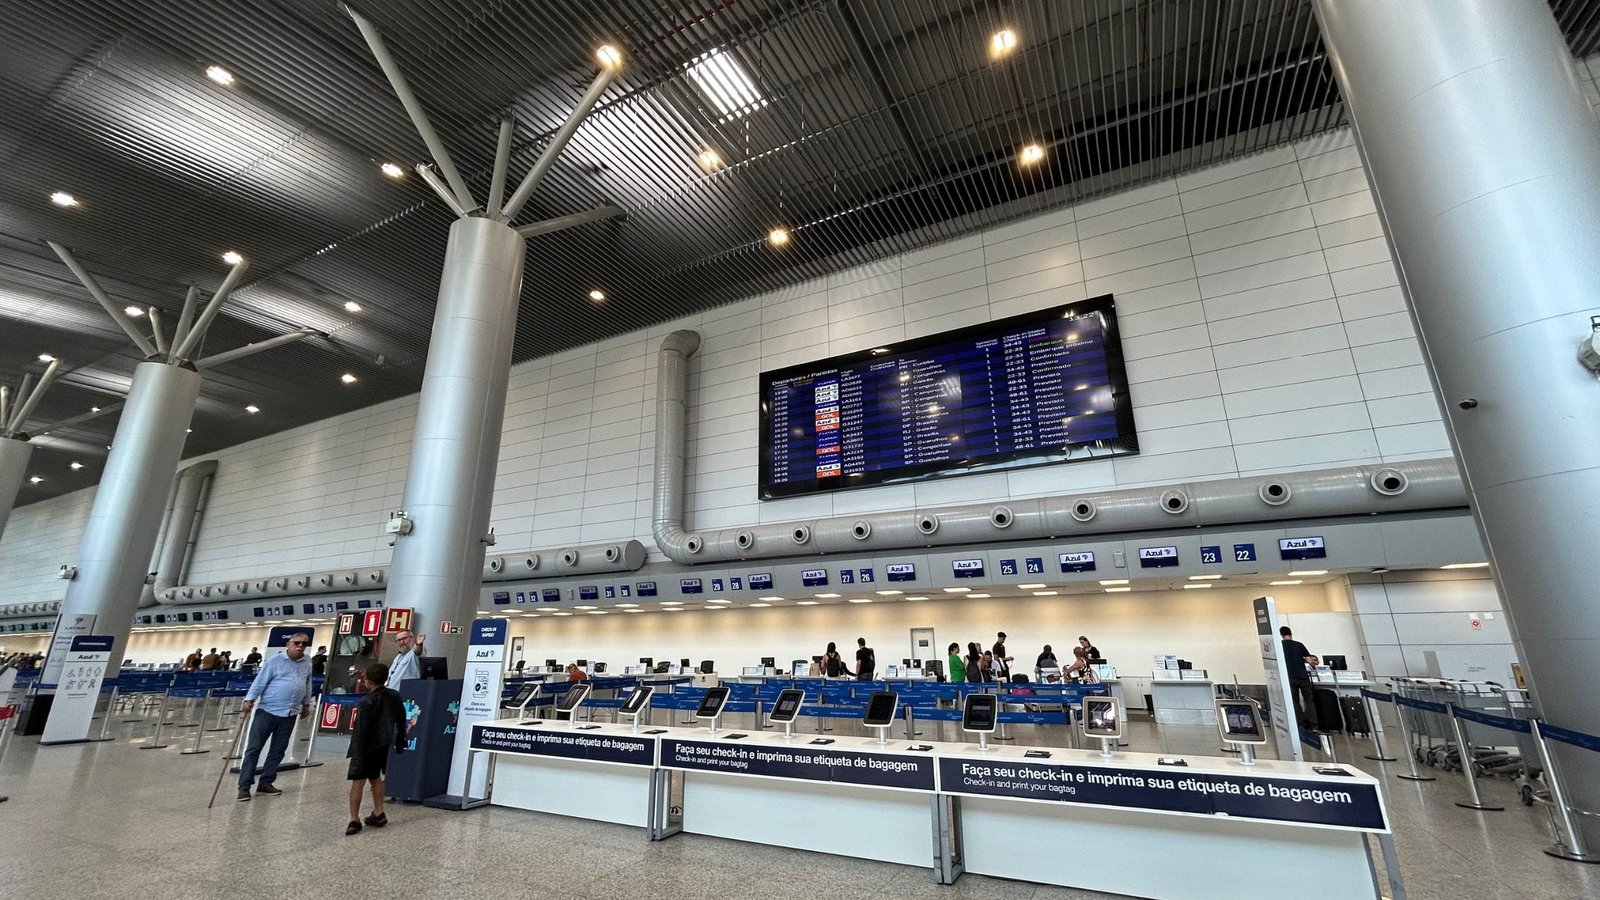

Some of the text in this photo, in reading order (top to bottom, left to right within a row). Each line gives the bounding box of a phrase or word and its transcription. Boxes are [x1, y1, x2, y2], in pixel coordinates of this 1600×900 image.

[1069, 312, 1094, 321] 13:22
[1029, 339, 1063, 348] Embarque
[1030, 340, 1093, 355] Embarque próximo
[1031, 351, 1069, 361] Confirmado
[913, 364, 942, 372] Guarulhos
[1032, 364, 1071, 373] Confirmado
[913, 370, 945, 378] Congonhas
[772, 376, 807, 386] Departures
[915, 394, 947, 402] Congonhas
[918, 442, 952, 450] Congonhas
[1286, 540, 1306, 548] Azul
[1203, 553, 1216, 563] 23
[1236, 551, 1250, 560] 22
[1002, 565, 1012, 574] 25
[1028, 564, 1038, 573] 24
[842, 575, 850, 583] 27
[861, 574, 870, 582] 26
[713, 583, 720, 591] 29
[342, 618, 351, 631] H
[390, 612, 407, 629] H
[482, 729, 495, 739] Faça
[507, 732, 531, 741] check-in
[537, 734, 561, 745] imprima
[575, 736, 600, 748] etiqueta
[602, 740, 611, 748] de
[612, 741, 644, 753] bagagem
[676, 744, 694, 756] Faça
[696, 747, 711, 756] seu
[712, 747, 747, 759] check-in
[756, 752, 793, 764] imprima
[795, 755, 811, 764] sua
[813, 754, 851, 767] etiqueta
[854, 757, 866, 768] de
[869, 760, 918, 772] bagagem
[731, 760, 748, 769] bagtag
[962, 763, 1352, 804] Faça seu check-in e imprima sua etiqueta de bagagem
[964, 777, 995, 787] Check-in
[997, 780, 1011, 788] and
[1012, 781, 1029, 790] print
[1048, 783, 1076, 794] bagtag
